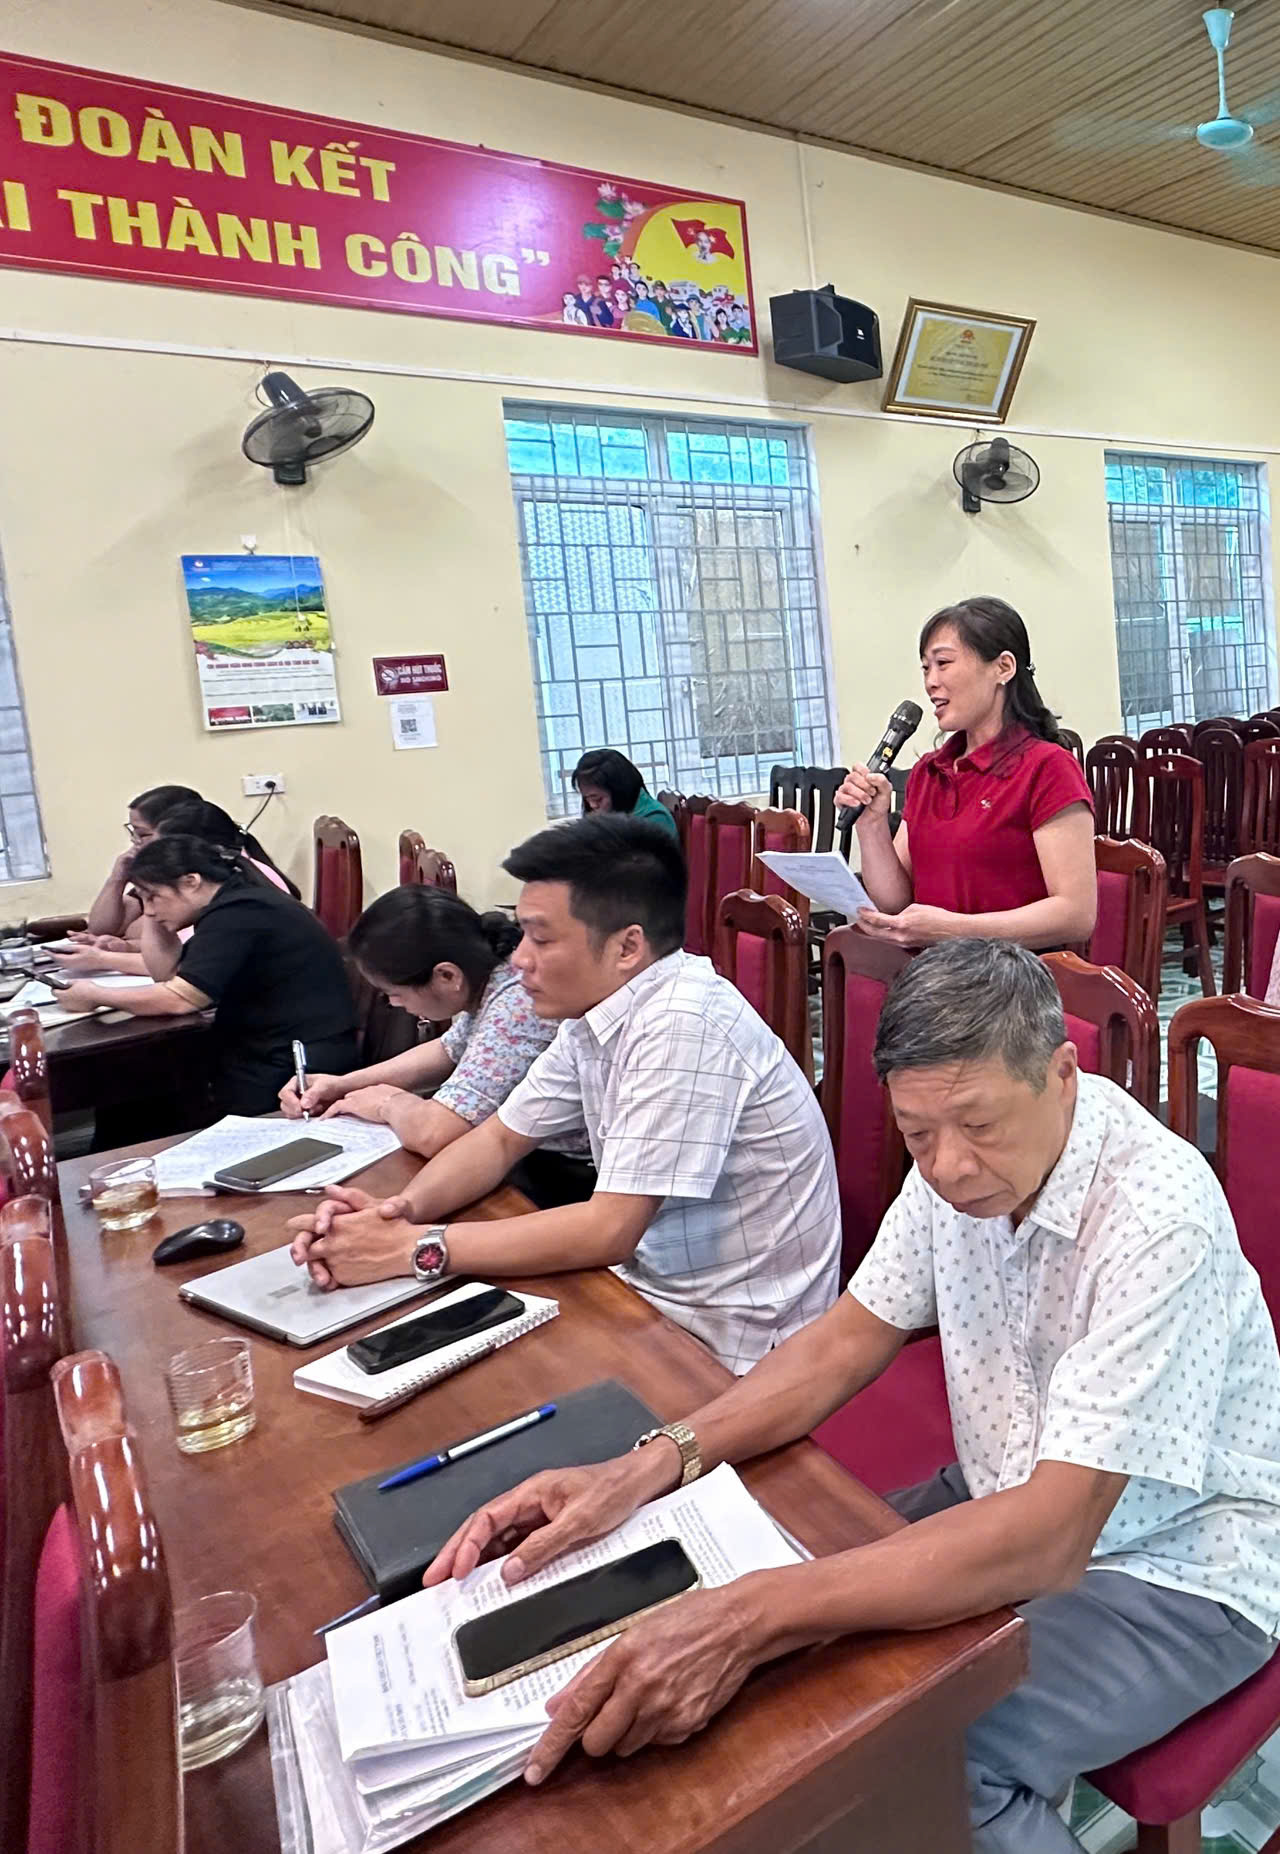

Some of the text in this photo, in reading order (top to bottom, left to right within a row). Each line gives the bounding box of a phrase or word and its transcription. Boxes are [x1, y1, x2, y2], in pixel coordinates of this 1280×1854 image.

[15, 92, 396, 202] ĐOÀN KẾT
[0, 180, 31, 232] I
[57, 189, 321, 269] THÀNH
